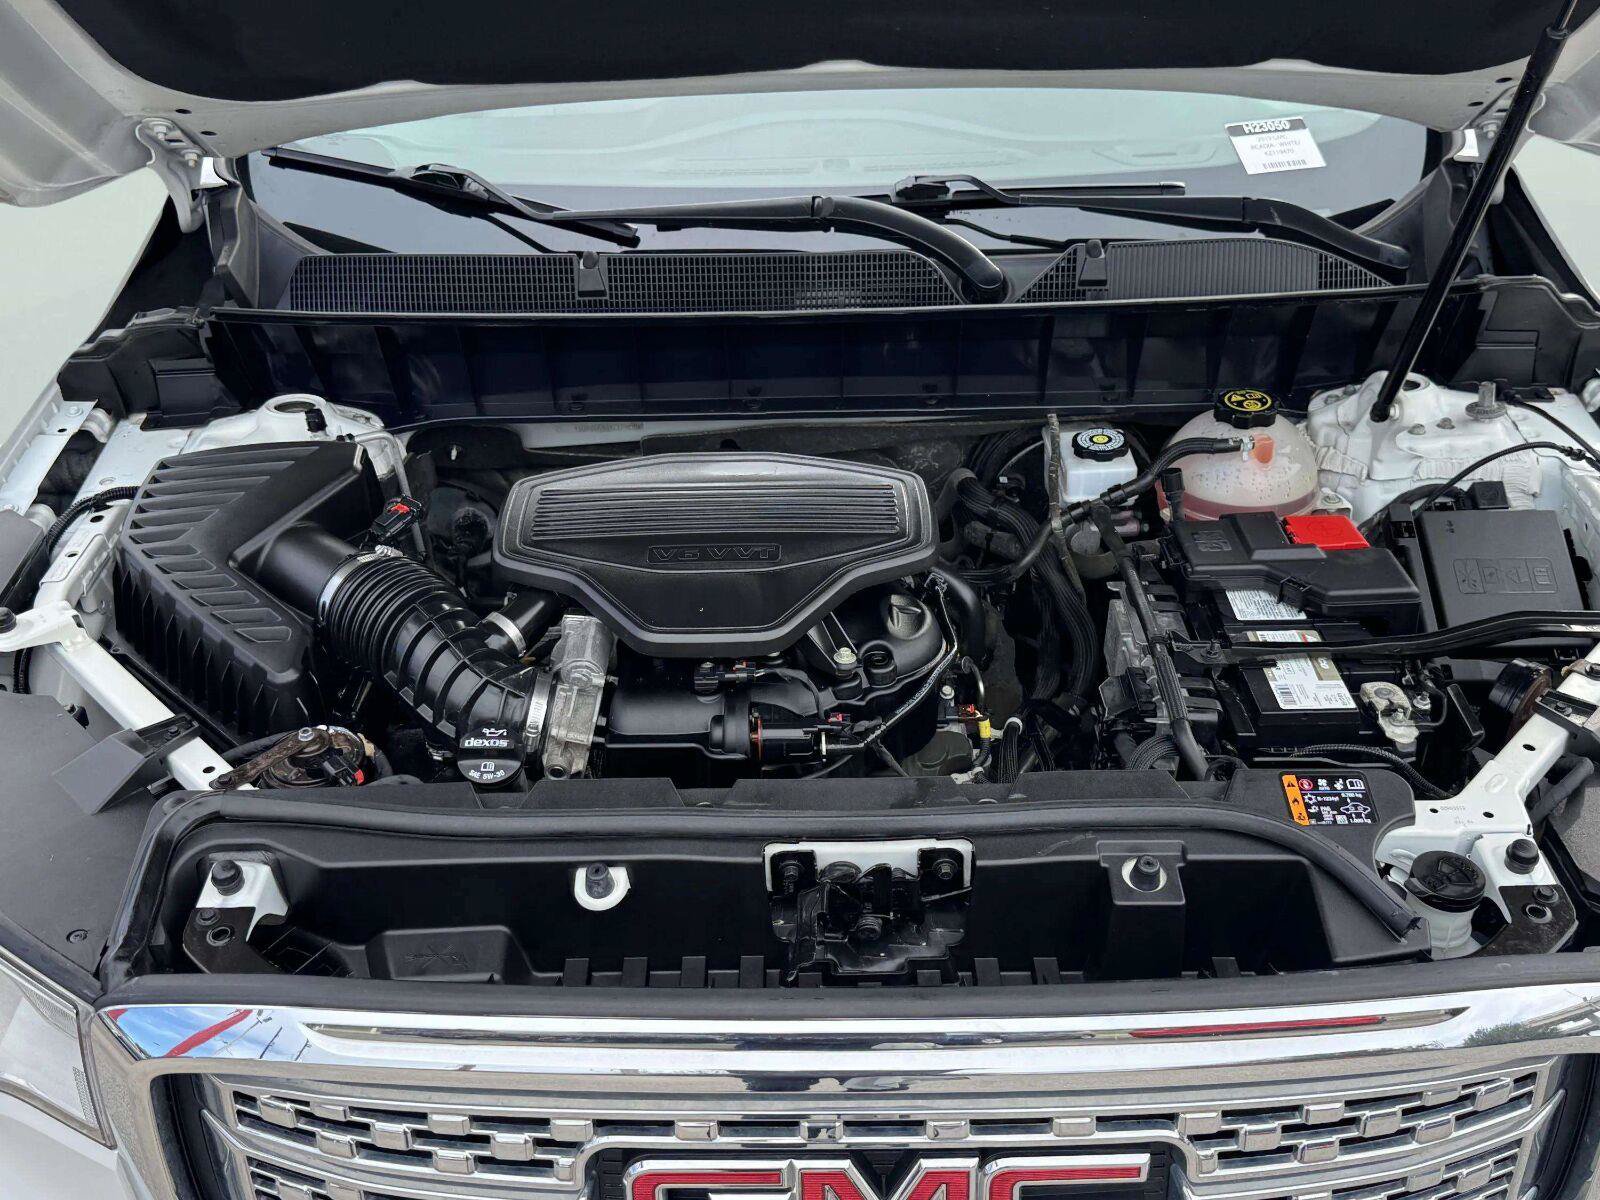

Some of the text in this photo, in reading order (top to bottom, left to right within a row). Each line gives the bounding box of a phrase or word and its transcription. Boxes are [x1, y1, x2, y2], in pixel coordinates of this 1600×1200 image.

[1242, 119, 1291, 135] H23050
[706, 547, 776, 559] VVT
[464, 737, 510, 748] dexos
[468, 769, 482, 779] SAE
